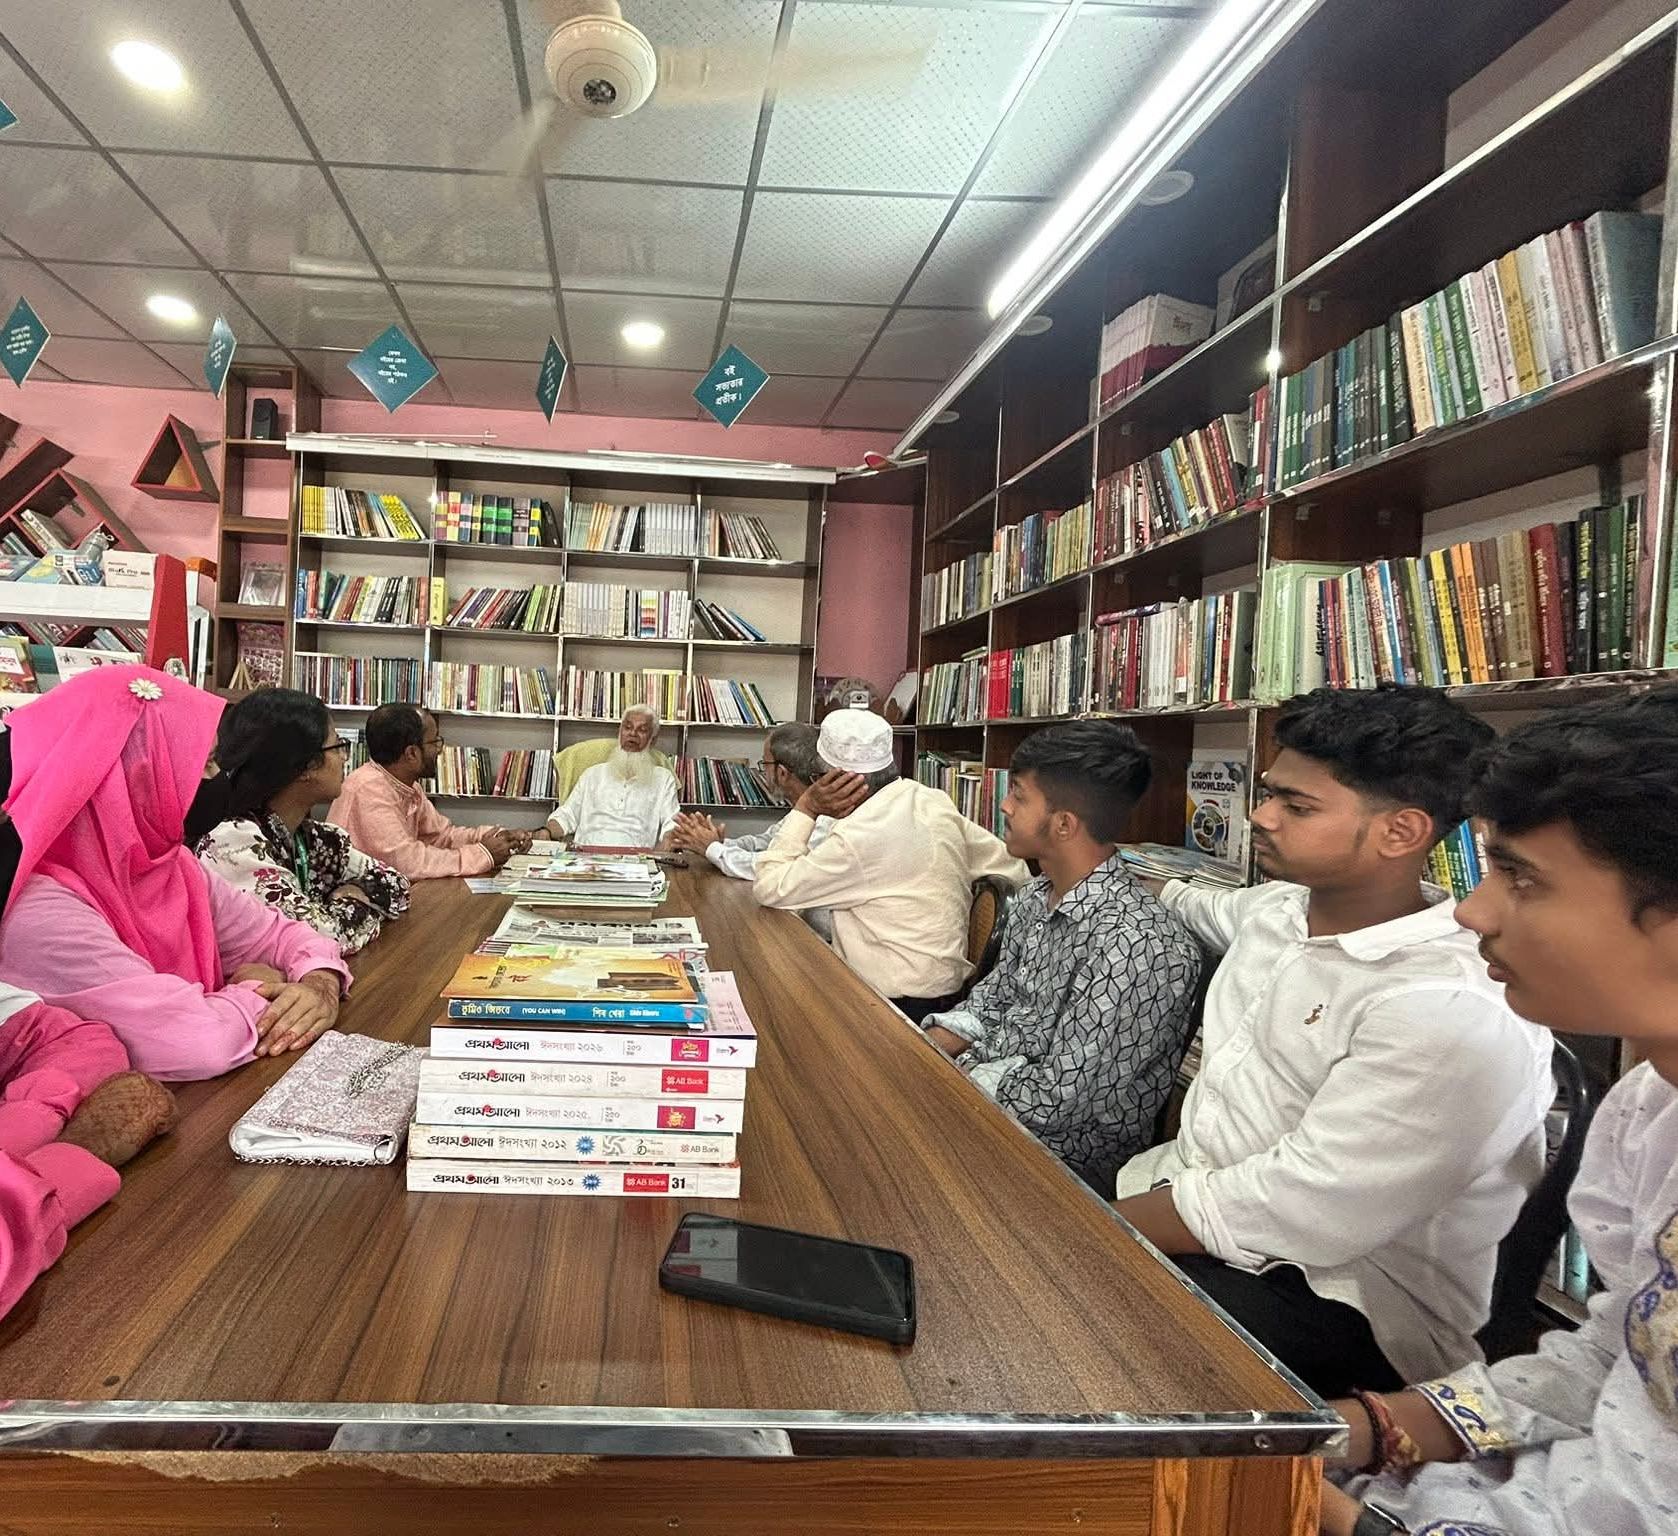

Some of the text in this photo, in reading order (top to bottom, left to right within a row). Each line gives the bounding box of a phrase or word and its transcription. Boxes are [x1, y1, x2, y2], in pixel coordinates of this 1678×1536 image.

[715, 378, 744, 391] সভ্যতার
[1191, 771, 1223, 780] LIGHT OF
[1191, 781, 1236, 791] KNOWLEDGE
[675, 1077, 686, 1085] AB
[541, 1140, 567, 1150] ২০১২
[690, 1144, 720, 1153] AB Bank
[547, 1178, 575, 1187] ২০১৩
[635, 1178, 667, 1187] AB Bank
[671, 1177, 686, 1190] 31
